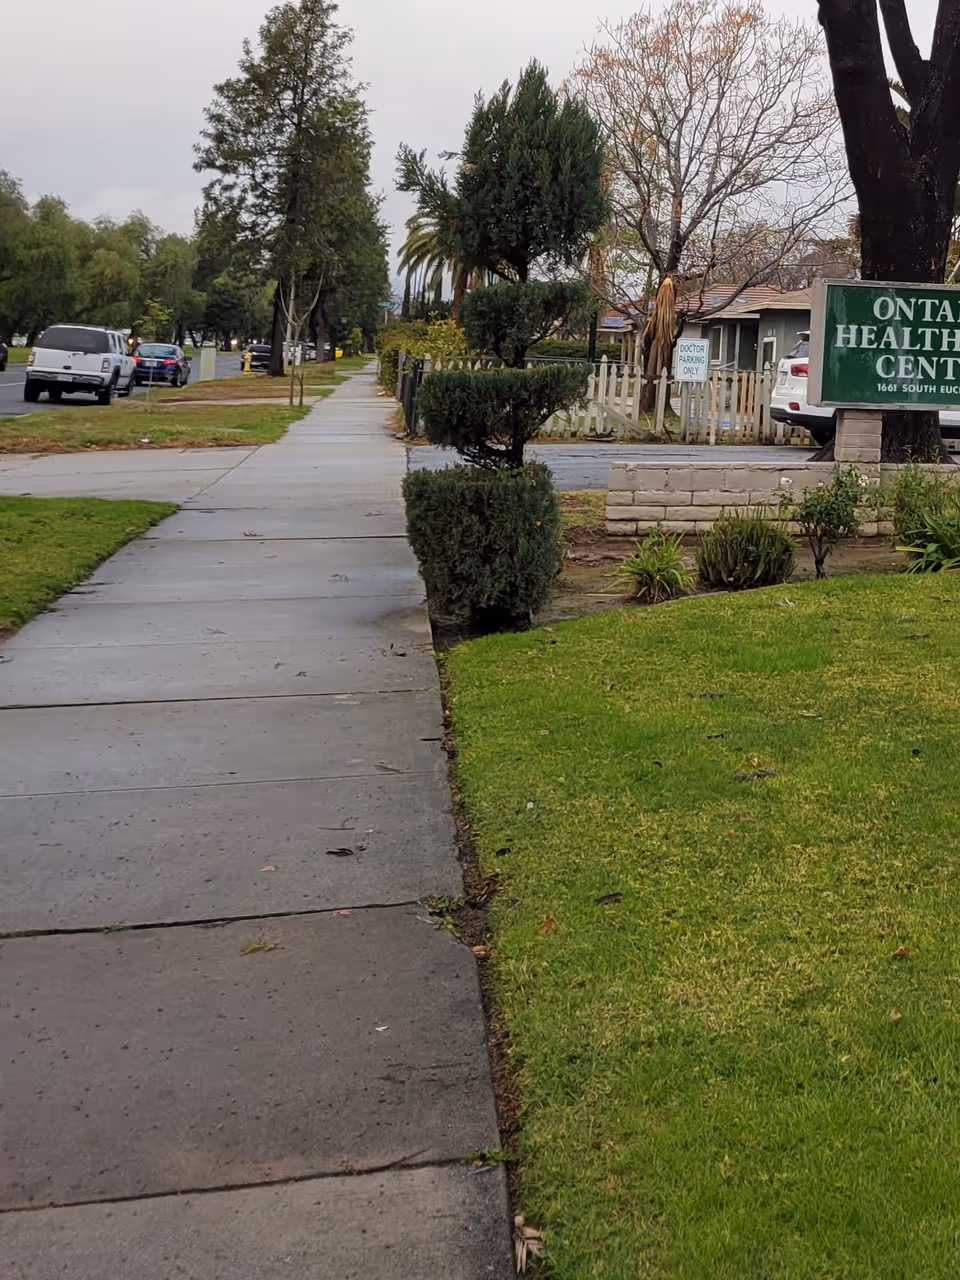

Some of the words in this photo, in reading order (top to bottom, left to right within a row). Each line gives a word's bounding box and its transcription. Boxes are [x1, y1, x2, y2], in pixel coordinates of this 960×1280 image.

[680, 344, 705, 353] DOCTOR
[679, 355, 705, 364] PARKING
[683, 366, 699, 375] ONLY
[877, 383, 897, 392] 1661
[902, 384, 936, 393] SOUTH
